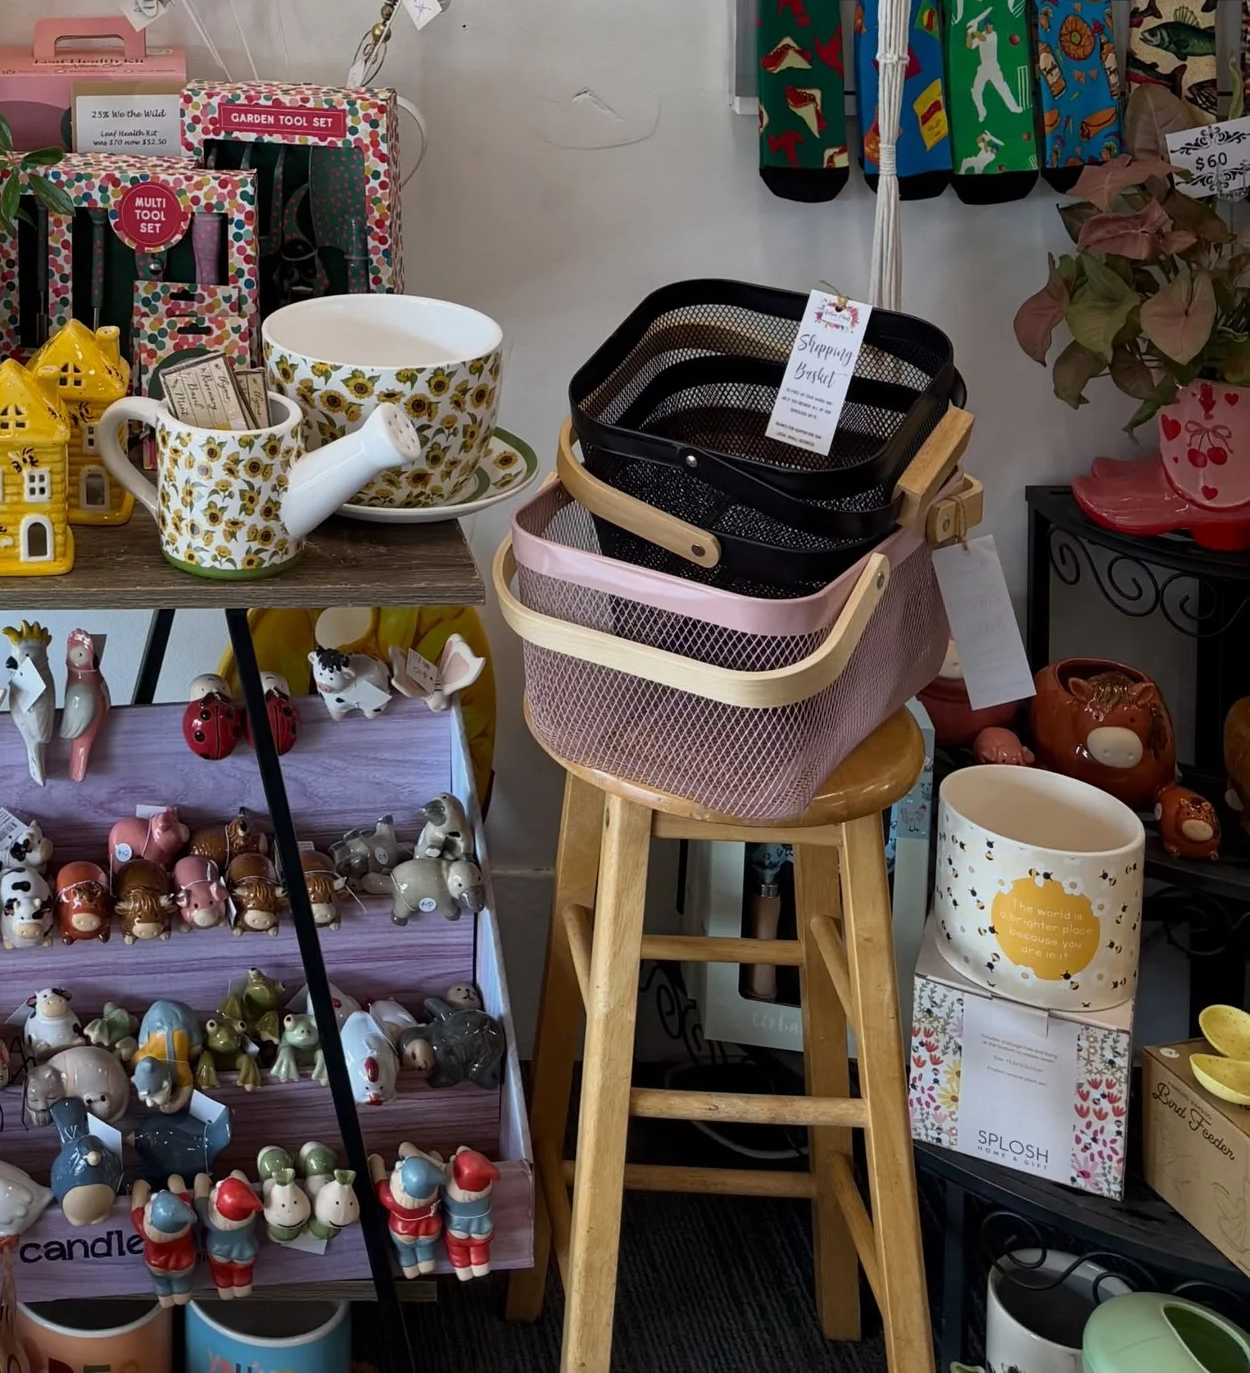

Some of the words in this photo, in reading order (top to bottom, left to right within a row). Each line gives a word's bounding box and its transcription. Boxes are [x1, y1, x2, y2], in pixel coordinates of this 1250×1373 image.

[91, 110, 110, 119] 25%
[111, 110, 126, 118] We
[126, 109, 144, 118] the
[144, 109, 166, 118] Wild
[231, 113, 275, 126] GARDEN
[279, 115, 309, 127] TOOL
[313, 117, 334, 128] SET
[100, 130, 117, 138] Leaf
[118, 129, 145, 137] Health
[1196, 152, 1228, 171] $60
[135, 197, 167, 208] MULTI
[135, 209, 167, 221] TOOL
[139, 222, 162, 234] SET
[798, 333, 853, 367] Shopping
[794, 361, 848, 389] Basket
[1012, 898, 1034, 913] The
[1037, 909, 1071, 920] world
[1074, 912, 1082, 920] is
[1010, 914, 1062, 932] brighter
[1062, 924, 1093, 936] place
[1009, 928, 1058, 946] because
[1061, 940, 1082, 949] you
[1021, 946, 1042, 957] are
[1046, 950, 1056, 959] in
[1059, 951, 1068, 960] it
[1152, 1082, 1187, 1119] Bird
[1188, 1108, 1236, 1161] Feeder
[977, 1145, 1007, 1159] HOME
[978, 1130, 1049, 1164] SPLOSH
[19, 1230, 144, 1264] candle
